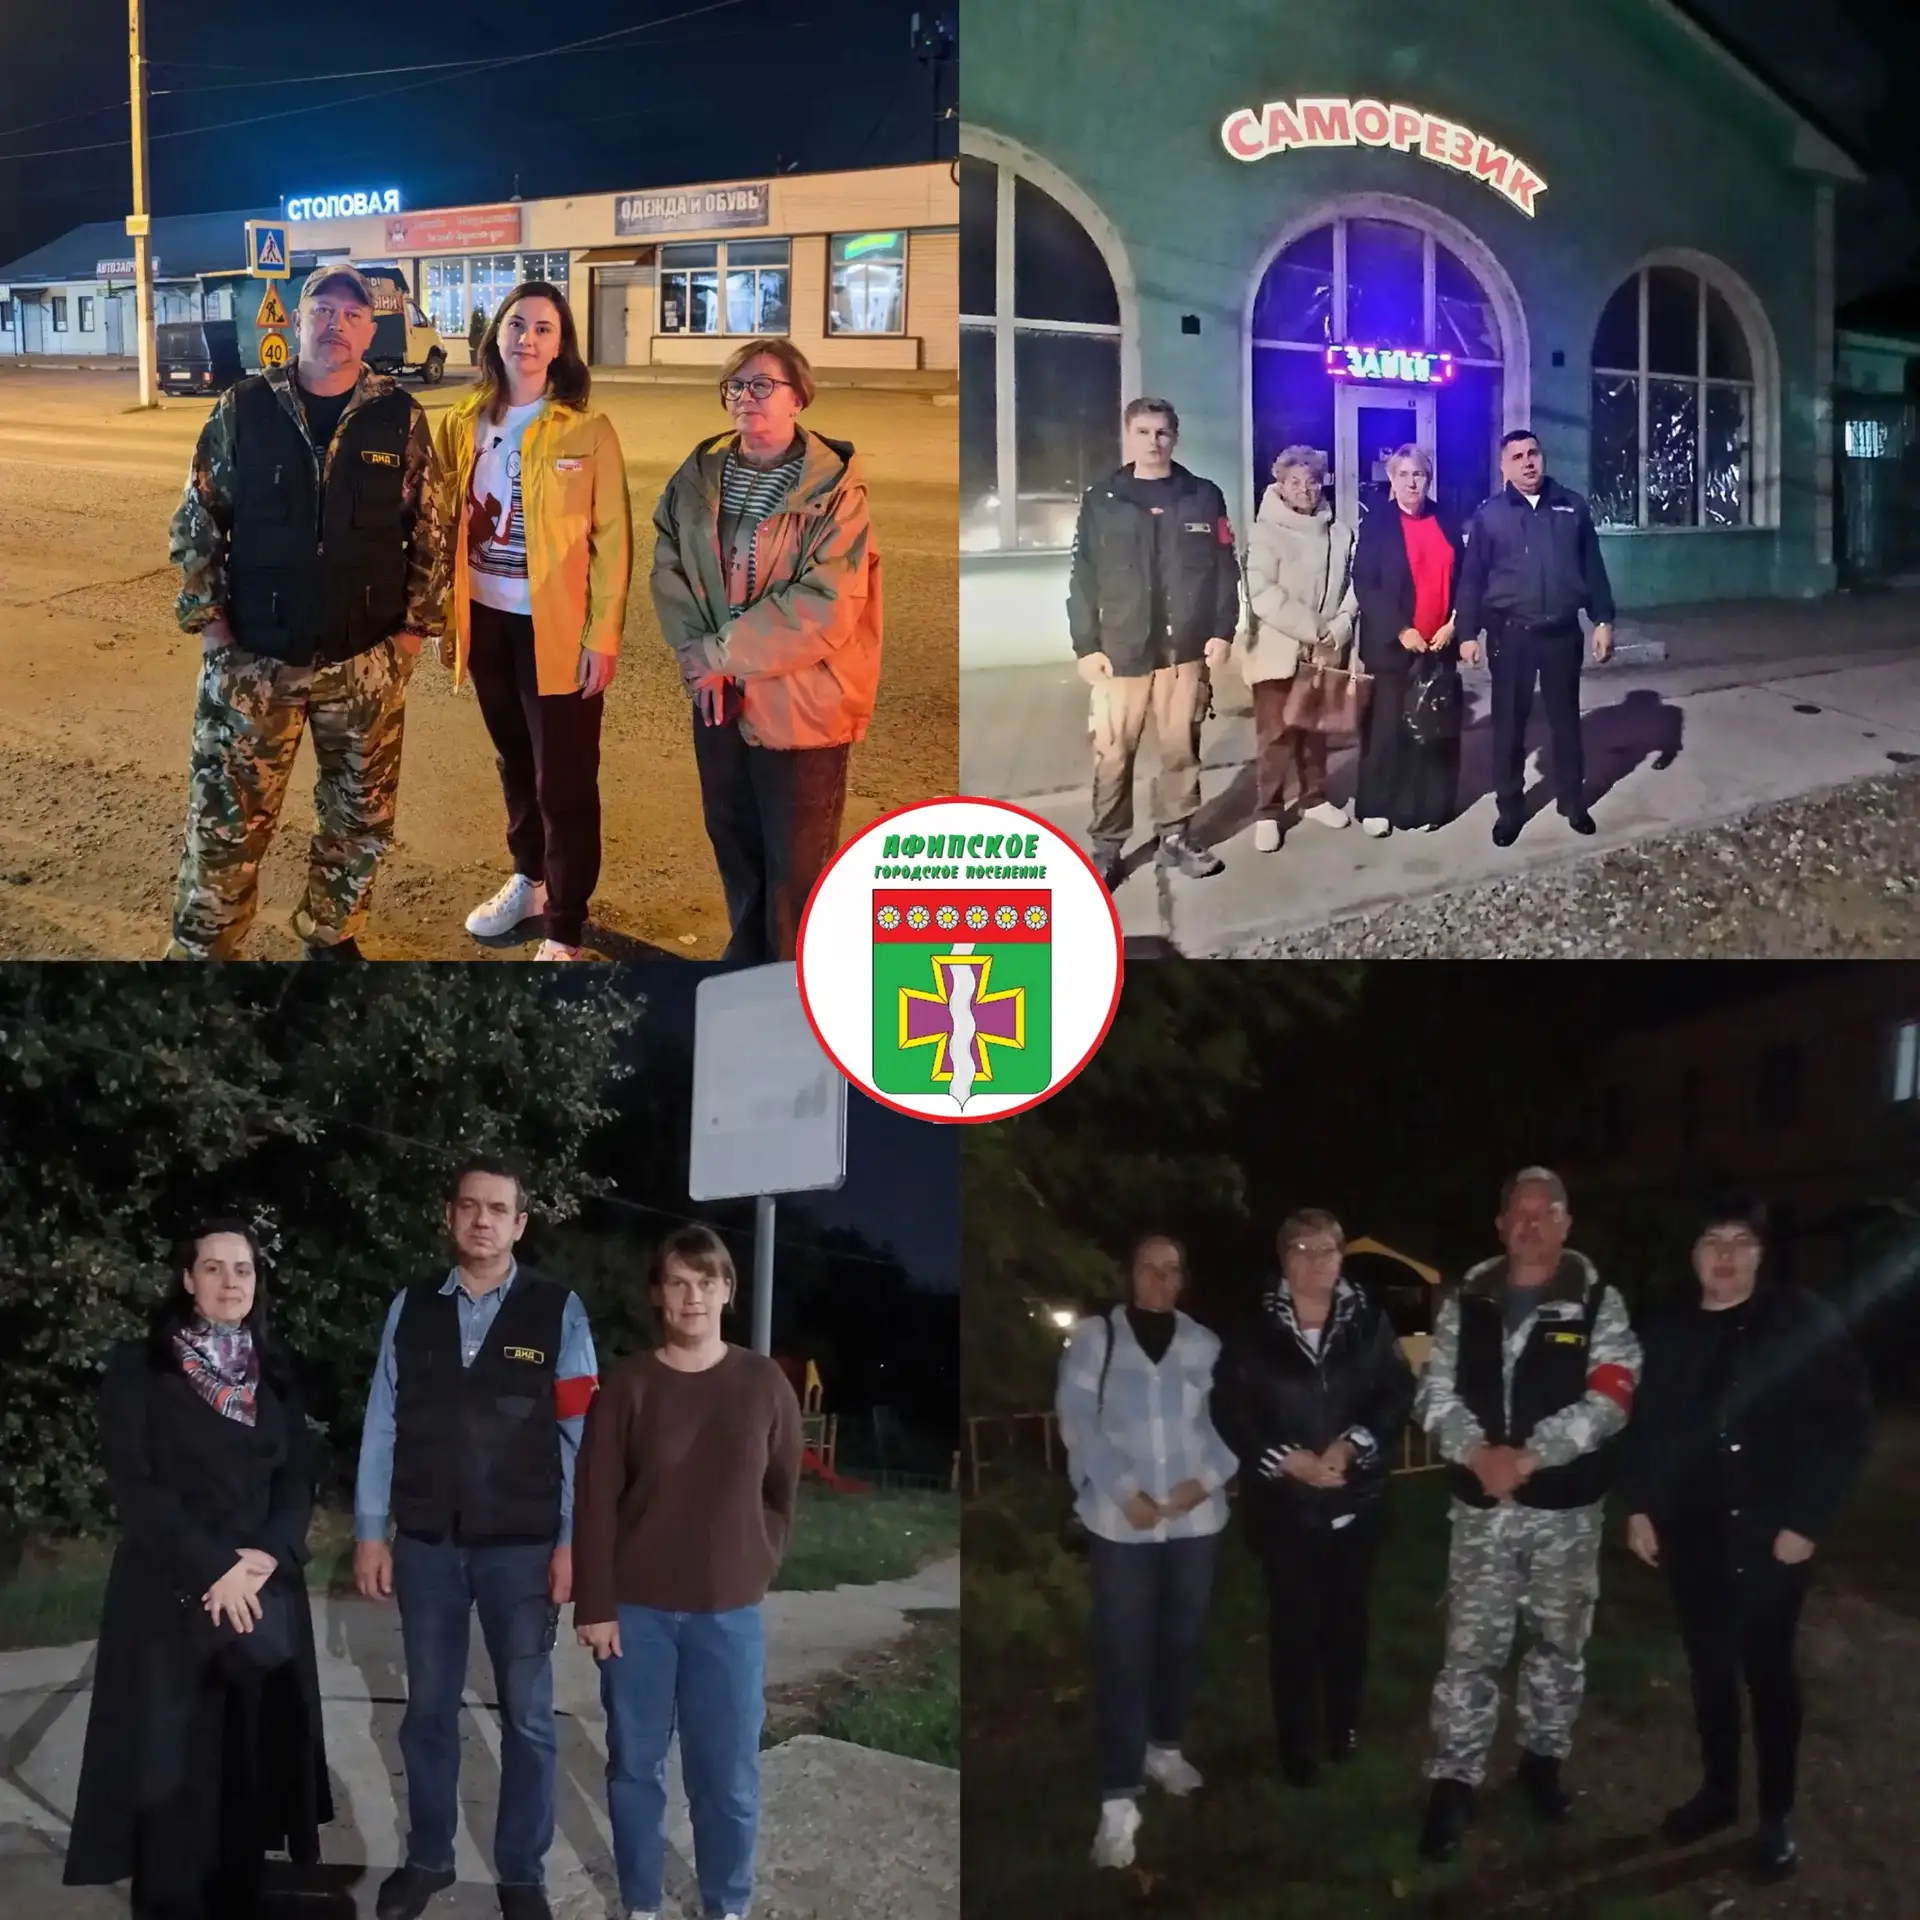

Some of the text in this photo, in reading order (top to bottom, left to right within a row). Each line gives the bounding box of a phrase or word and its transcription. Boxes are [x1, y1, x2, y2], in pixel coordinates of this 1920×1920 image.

[1223, 99, 1547, 218] САМОРЕЗИК
[288, 189, 399, 220] СТОЛОВАЯ
[621, 196, 687, 221] ОДЕЖДА
[705, 189, 760, 212] ОБУВЬ
[97, 260, 158, 274] АВТОЗАПЧИ
[265, 344, 282, 361] 40
